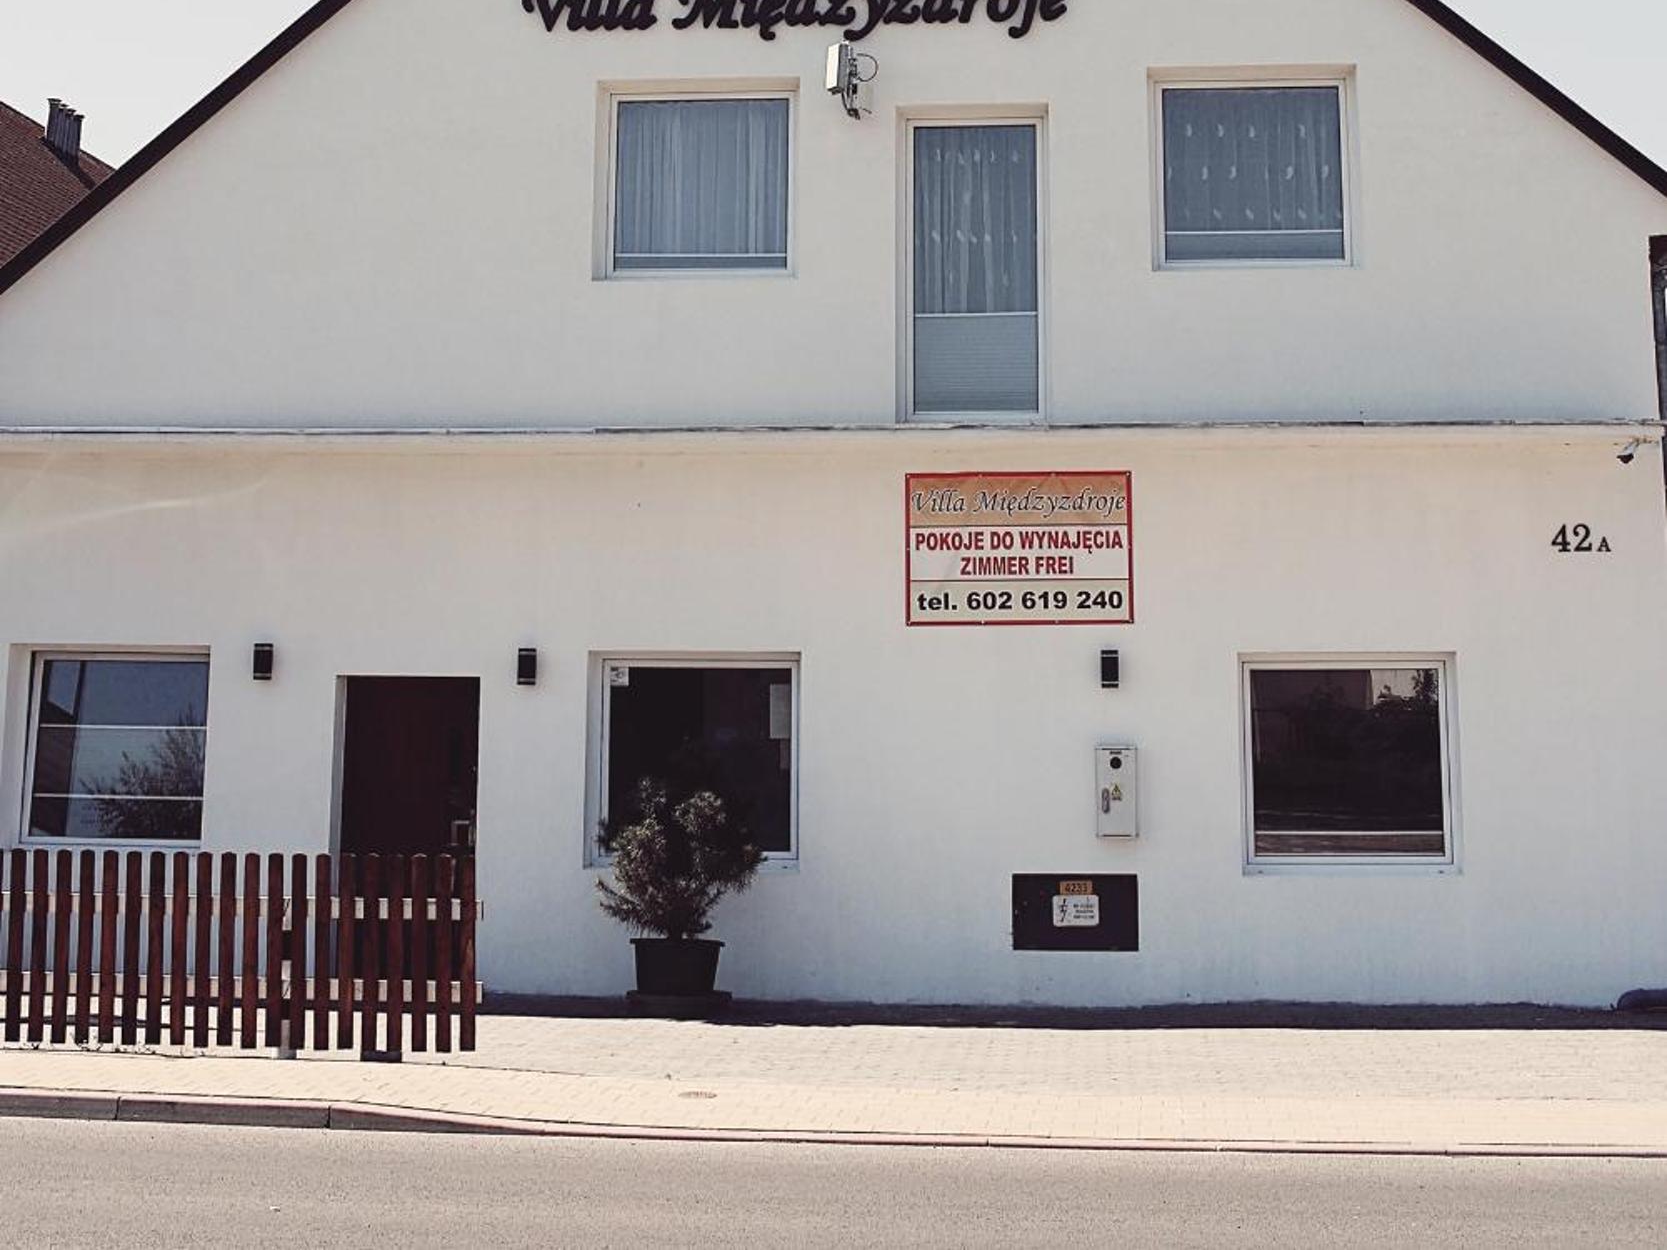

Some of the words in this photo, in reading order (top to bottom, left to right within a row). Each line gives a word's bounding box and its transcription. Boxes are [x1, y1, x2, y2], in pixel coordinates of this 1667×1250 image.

[911, 489, 966, 513] Villa
[973, 487, 1126, 518] Międzyzdroje
[915, 532, 984, 551] POKOJE
[990, 531, 1014, 550] DO
[1019, 530, 1123, 554] WYNAJĘCIA
[960, 557, 1030, 575] ZIMMER
[1035, 556, 1074, 574] FREI
[917, 593, 957, 610] tel.
[966, 592, 1012, 610] 602
[1021, 592, 1067, 609] 619
[1076, 591, 1123, 609] 240
